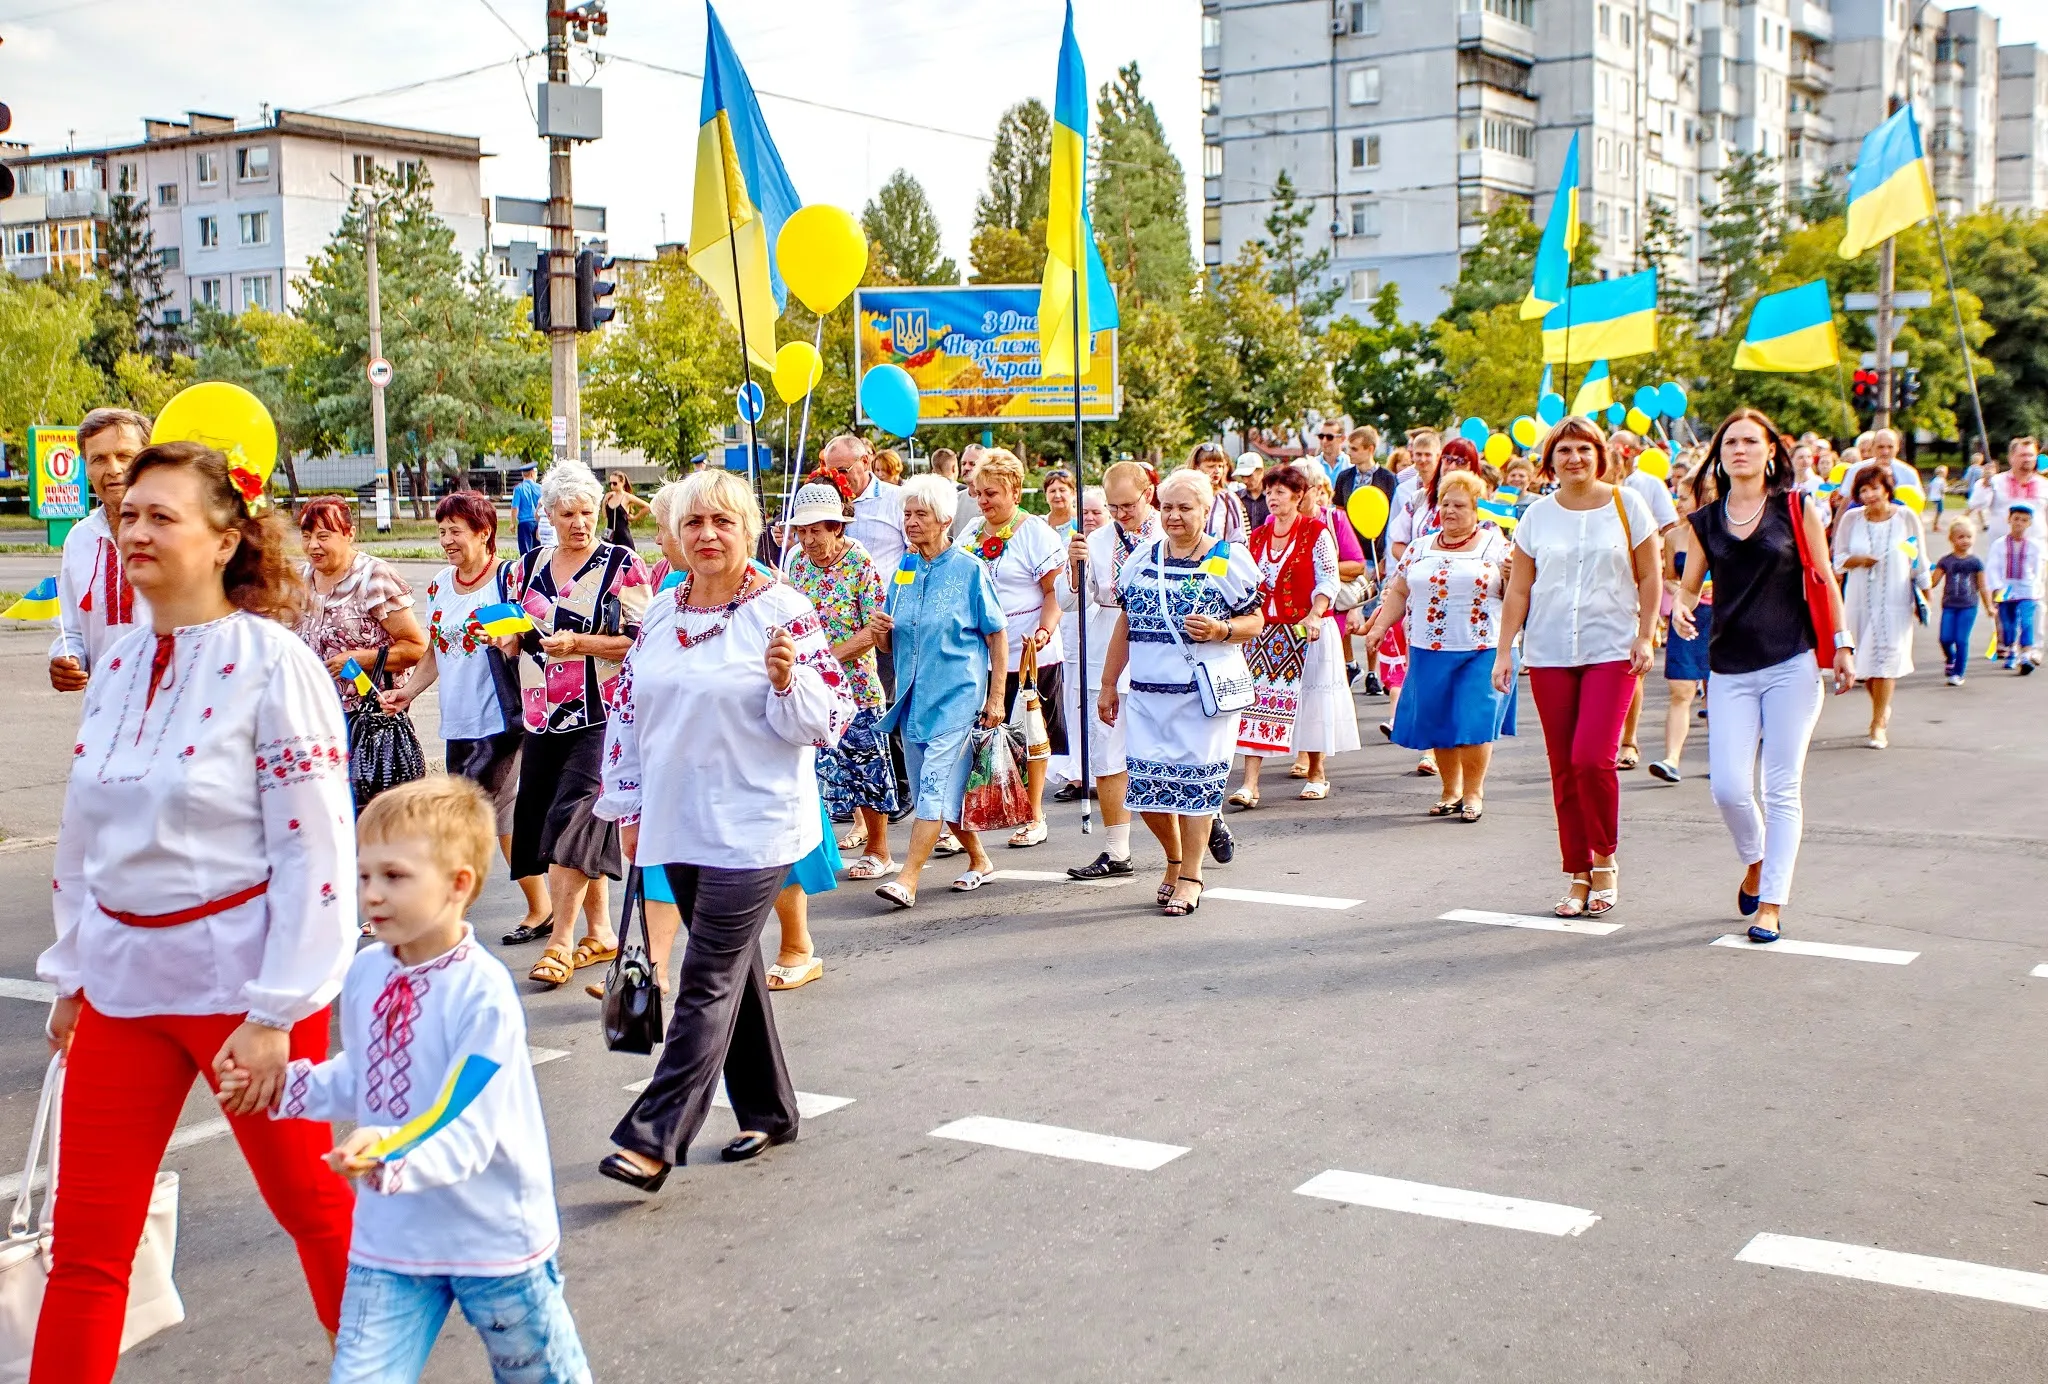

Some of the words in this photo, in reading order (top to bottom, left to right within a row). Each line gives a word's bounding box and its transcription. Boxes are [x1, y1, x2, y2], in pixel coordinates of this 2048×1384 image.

[981, 311, 998, 333] З
[999, 310, 1038, 332] Дне
[944, 333, 1097, 360] Незалежі
[38, 434, 76, 442] ПРОДАЖ
